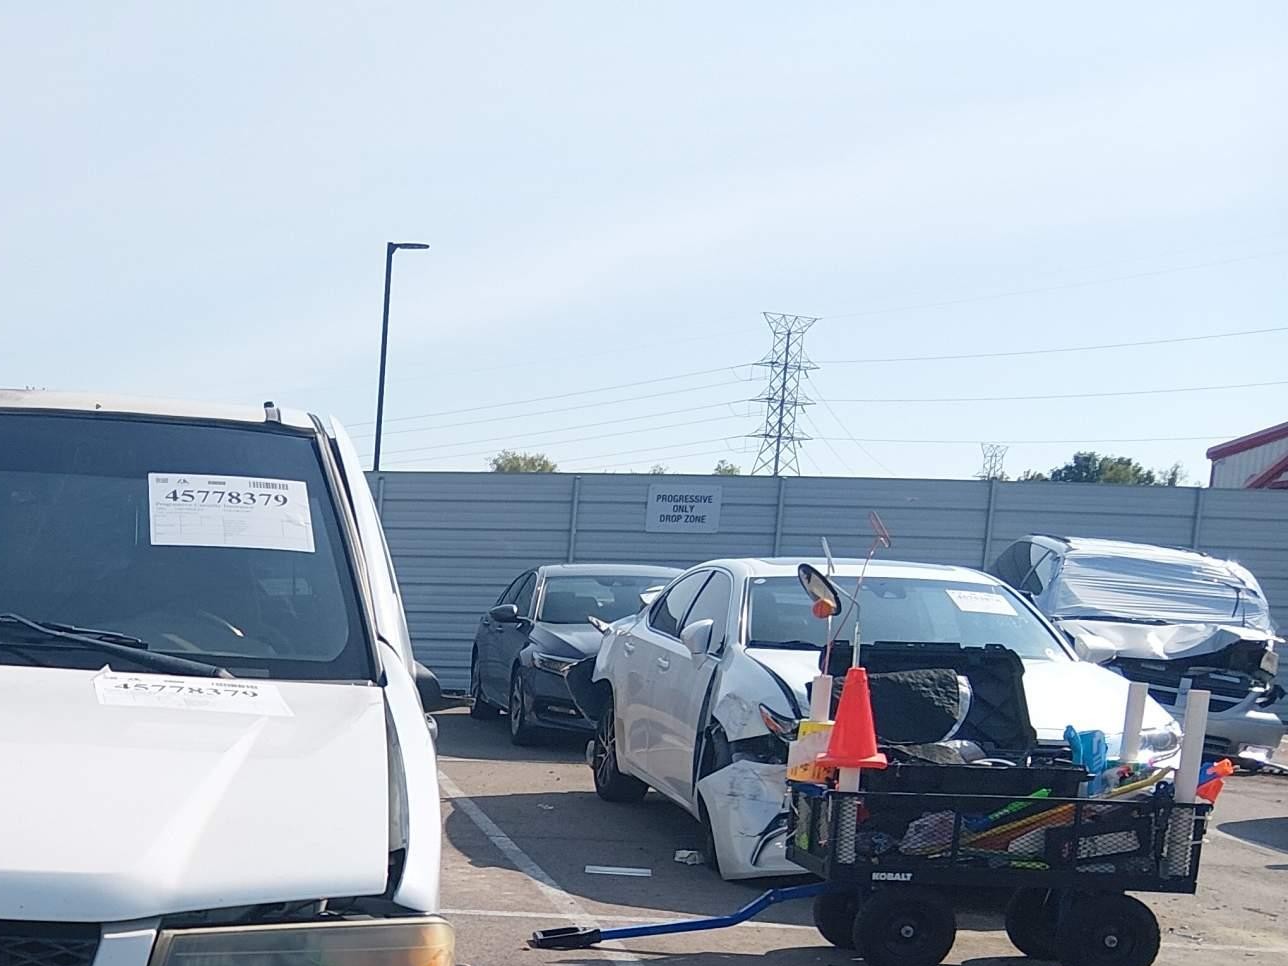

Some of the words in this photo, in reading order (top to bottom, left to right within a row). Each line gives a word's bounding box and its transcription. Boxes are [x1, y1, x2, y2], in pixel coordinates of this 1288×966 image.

[165, 489, 288, 507] 45778379
[656, 494, 713, 503] PROGRESSIVE
[672, 504, 695, 513] ONLY
[659, 514, 682, 523] DROP
[684, 515, 706, 523] ZONE
[114, 683, 258, 698] 45778379
[871, 872, 913, 881] KOBALT
